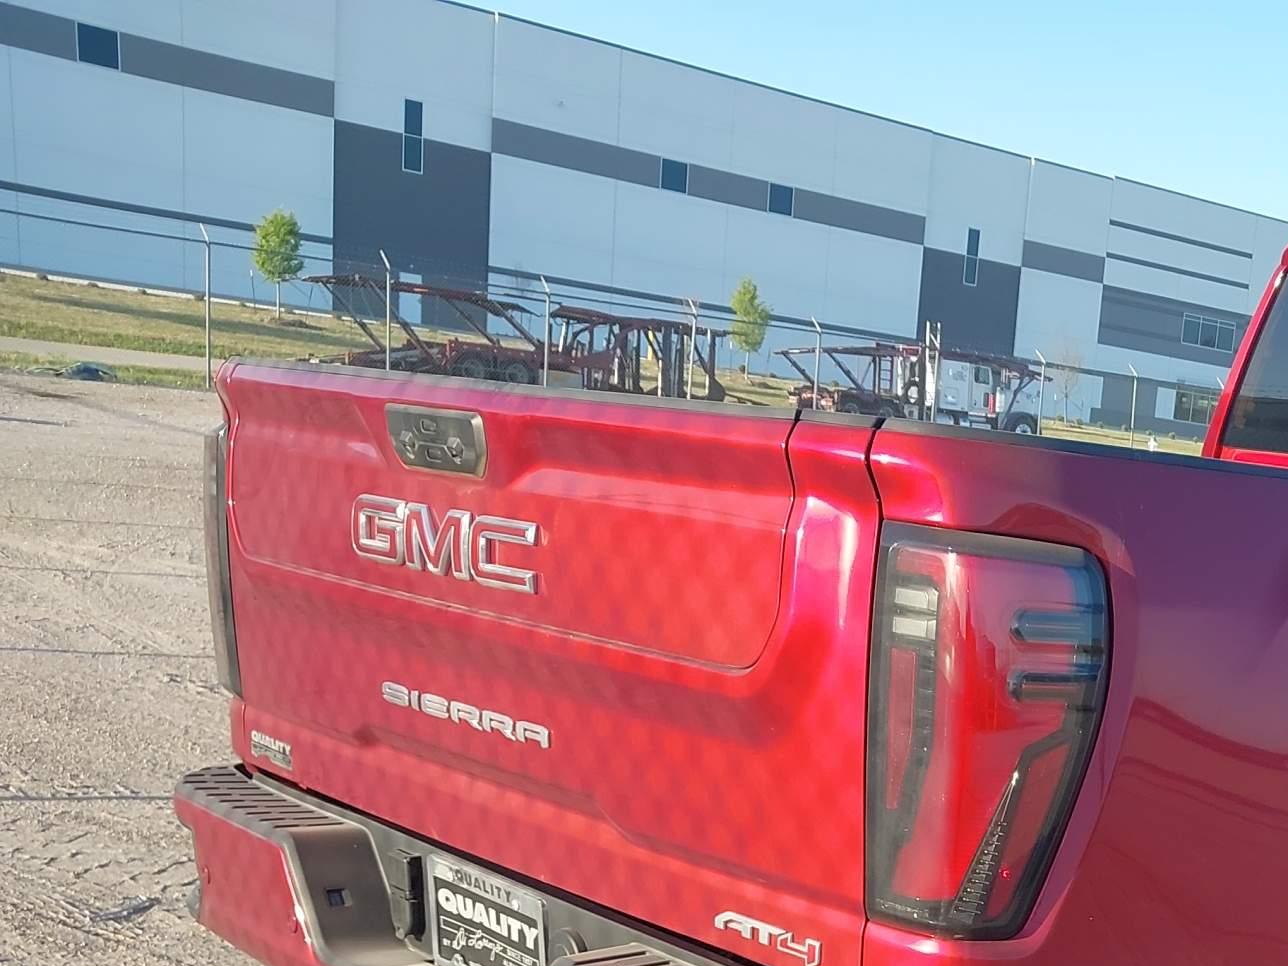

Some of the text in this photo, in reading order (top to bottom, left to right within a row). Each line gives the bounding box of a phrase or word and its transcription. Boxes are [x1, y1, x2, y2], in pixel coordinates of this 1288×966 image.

[351, 493, 539, 595] GMC
[251, 730, 291, 755] QUALITY
[381, 681, 551, 750] SIERRA
[455, 869, 512, 903] QUALITY
[437, 888, 539, 950] QUALITY
